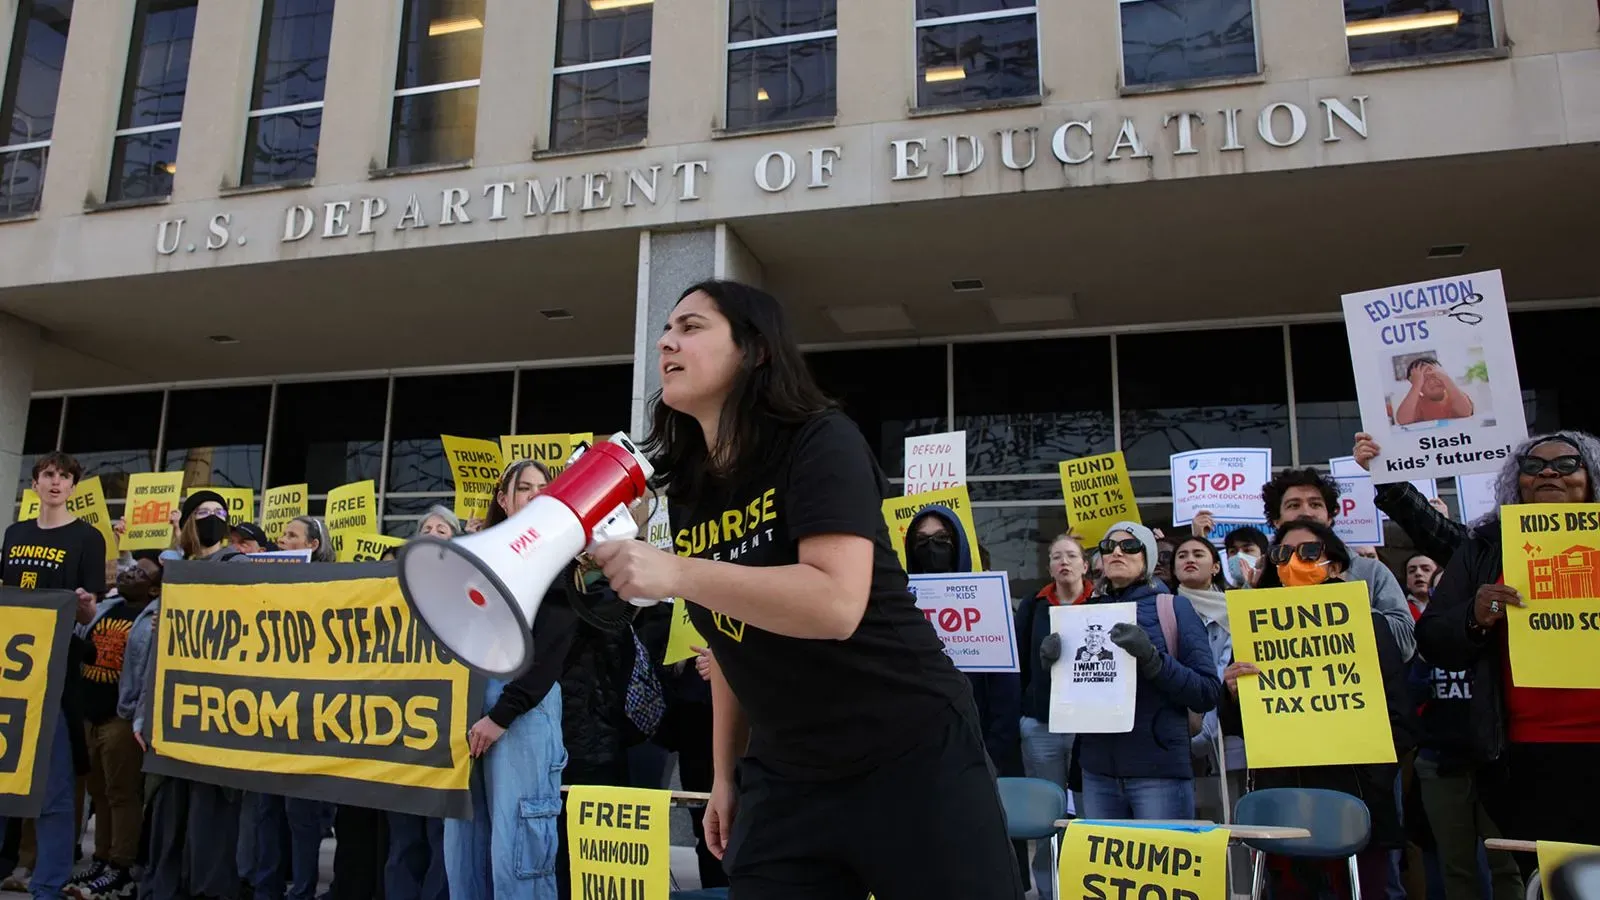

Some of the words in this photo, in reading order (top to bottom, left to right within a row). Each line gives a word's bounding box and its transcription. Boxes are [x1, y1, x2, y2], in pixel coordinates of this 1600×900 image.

[155, 212, 246, 255] U.S.
[281, 159, 708, 243] DEPARTMENT
[754, 145, 842, 193] OF
[890, 94, 1370, 181] EDUCATION
[1364, 280, 1474, 323] EDUCATION
[1381, 319, 1429, 345] CUTS
[912, 444, 952, 455] DEFEND
[1419, 433, 1472, 450] Slash
[453, 450, 496, 463] TRUMP:
[511, 443, 562, 460] FUND
[1436, 445, 1511, 466] futures!
[458, 465, 500, 480] STOP
[907, 462, 956, 480] CIVIL
[1068, 457, 1114, 477] FUND
[1070, 474, 1119, 492] EDUCATION
[1187, 473, 1246, 494] STOP
[65, 492, 95, 512] REE
[268, 491, 301, 507] FUND
[331, 496, 365, 514] FREE
[1073, 493, 1100, 509] NOT
[1103, 488, 1124, 504] 1%
[329, 514, 366, 530] MAHMOUD
[675, 488, 777, 557] SUNRISE
[895, 506, 916, 520] KIDS
[1076, 509, 1097, 522] TAX
[1099, 504, 1127, 517] CUTS
[264, 521, 283, 534] NOT
[1520, 514, 1560, 533] KIDS
[9, 545, 66, 562] SUNRISE
[9, 559, 59, 569] MOVEMENT
[946, 585, 978, 593] PROTECT
[922, 607, 981, 632] TOP
[1249, 602, 1350, 633] FUND
[1529, 612, 1575, 631] GOOD
[166, 609, 249, 662] TRUMP:
[256, 609, 316, 664] STOP
[952, 635, 1004, 643] EDUCATION!
[1253, 632, 1356, 662] EDUCATION
[1073, 663, 1077, 671] I
[1078, 662, 1100, 671] WANT
[1101, 661, 1116, 671] YOU
[1258, 666, 1313, 691] NOT
[1322, 662, 1361, 687] 1%
[1433, 682, 1472, 699] EAL
[1262, 696, 1305, 714] TAX
[1311, 692, 1365, 712] CUTS
[172, 682, 300, 740] FROM
[313, 692, 439, 750] KIDS
[579, 801, 651, 830] FREE
[579, 837, 649, 866] MAHMOUD
[1087, 835, 1202, 877] TRUMP:
